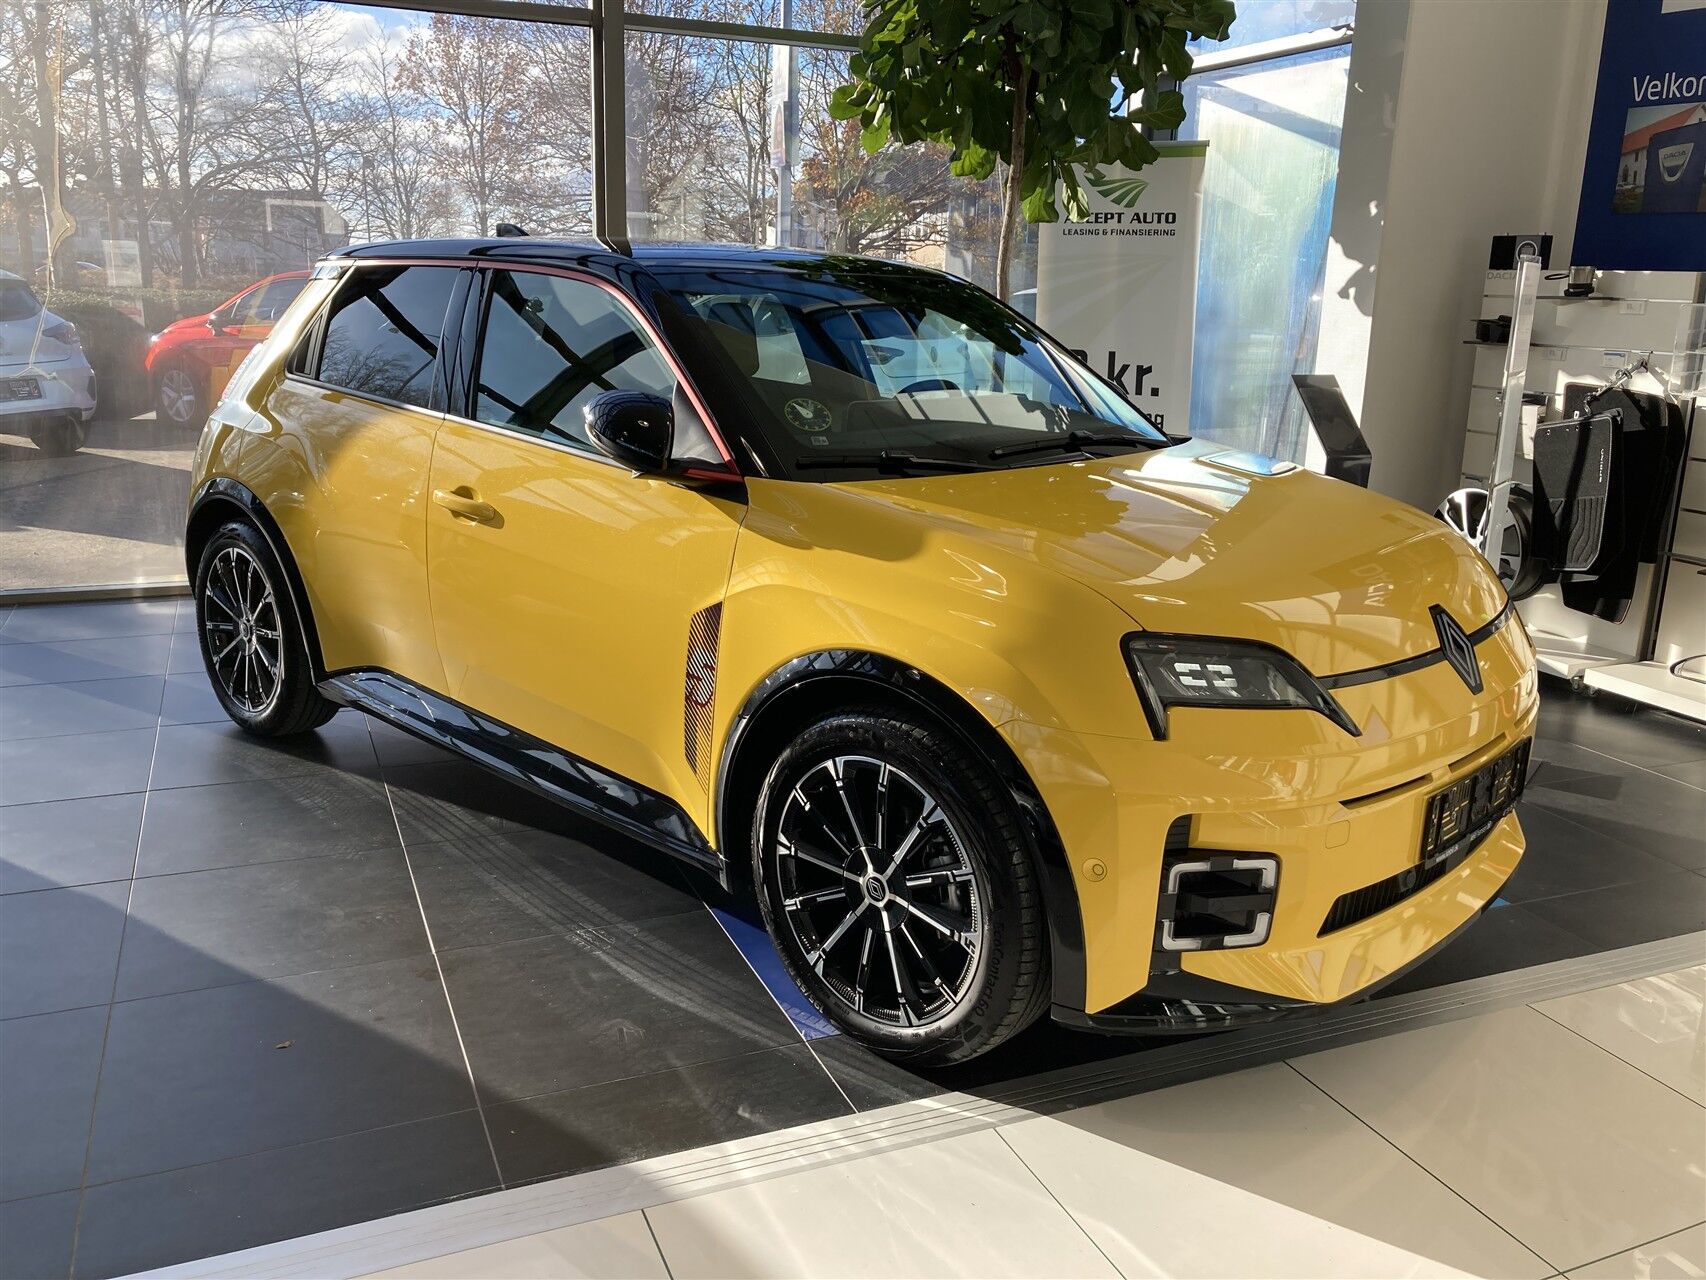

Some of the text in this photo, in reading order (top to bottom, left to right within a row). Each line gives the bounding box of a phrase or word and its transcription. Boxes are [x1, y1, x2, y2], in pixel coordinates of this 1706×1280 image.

[1130, 212, 1177, 224] AUTO
[1062, 228, 1176, 237] LEASING & FINANSIERING
[1107, 351, 1160, 397] kr.
